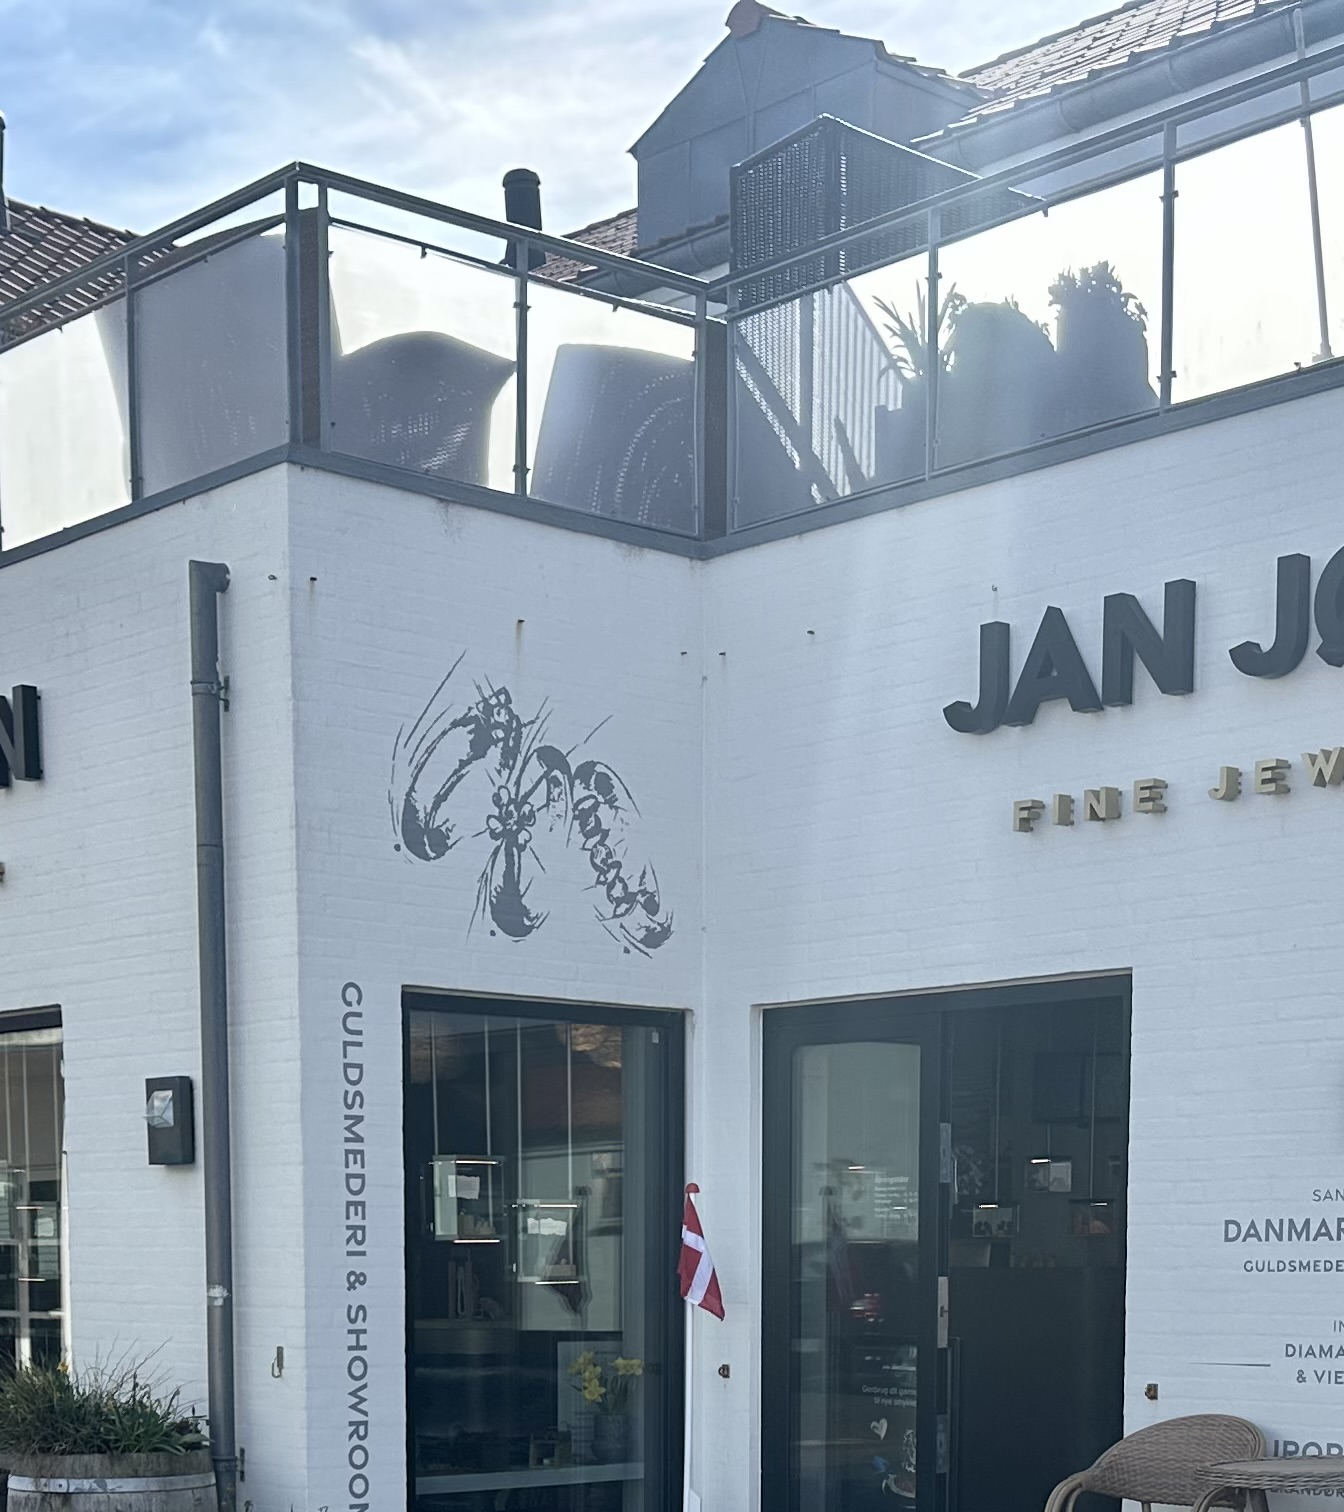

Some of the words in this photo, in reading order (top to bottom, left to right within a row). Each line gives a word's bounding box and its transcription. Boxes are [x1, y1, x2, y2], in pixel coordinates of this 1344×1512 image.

[942, 578, 1197, 734] JAN
[1013, 777, 1168, 833] FINE
[341, 981, 366, 1257] GULDSMEDERI
[347, 1270, 367, 1292] &
[1296, 1369, 1307, 1385] &
